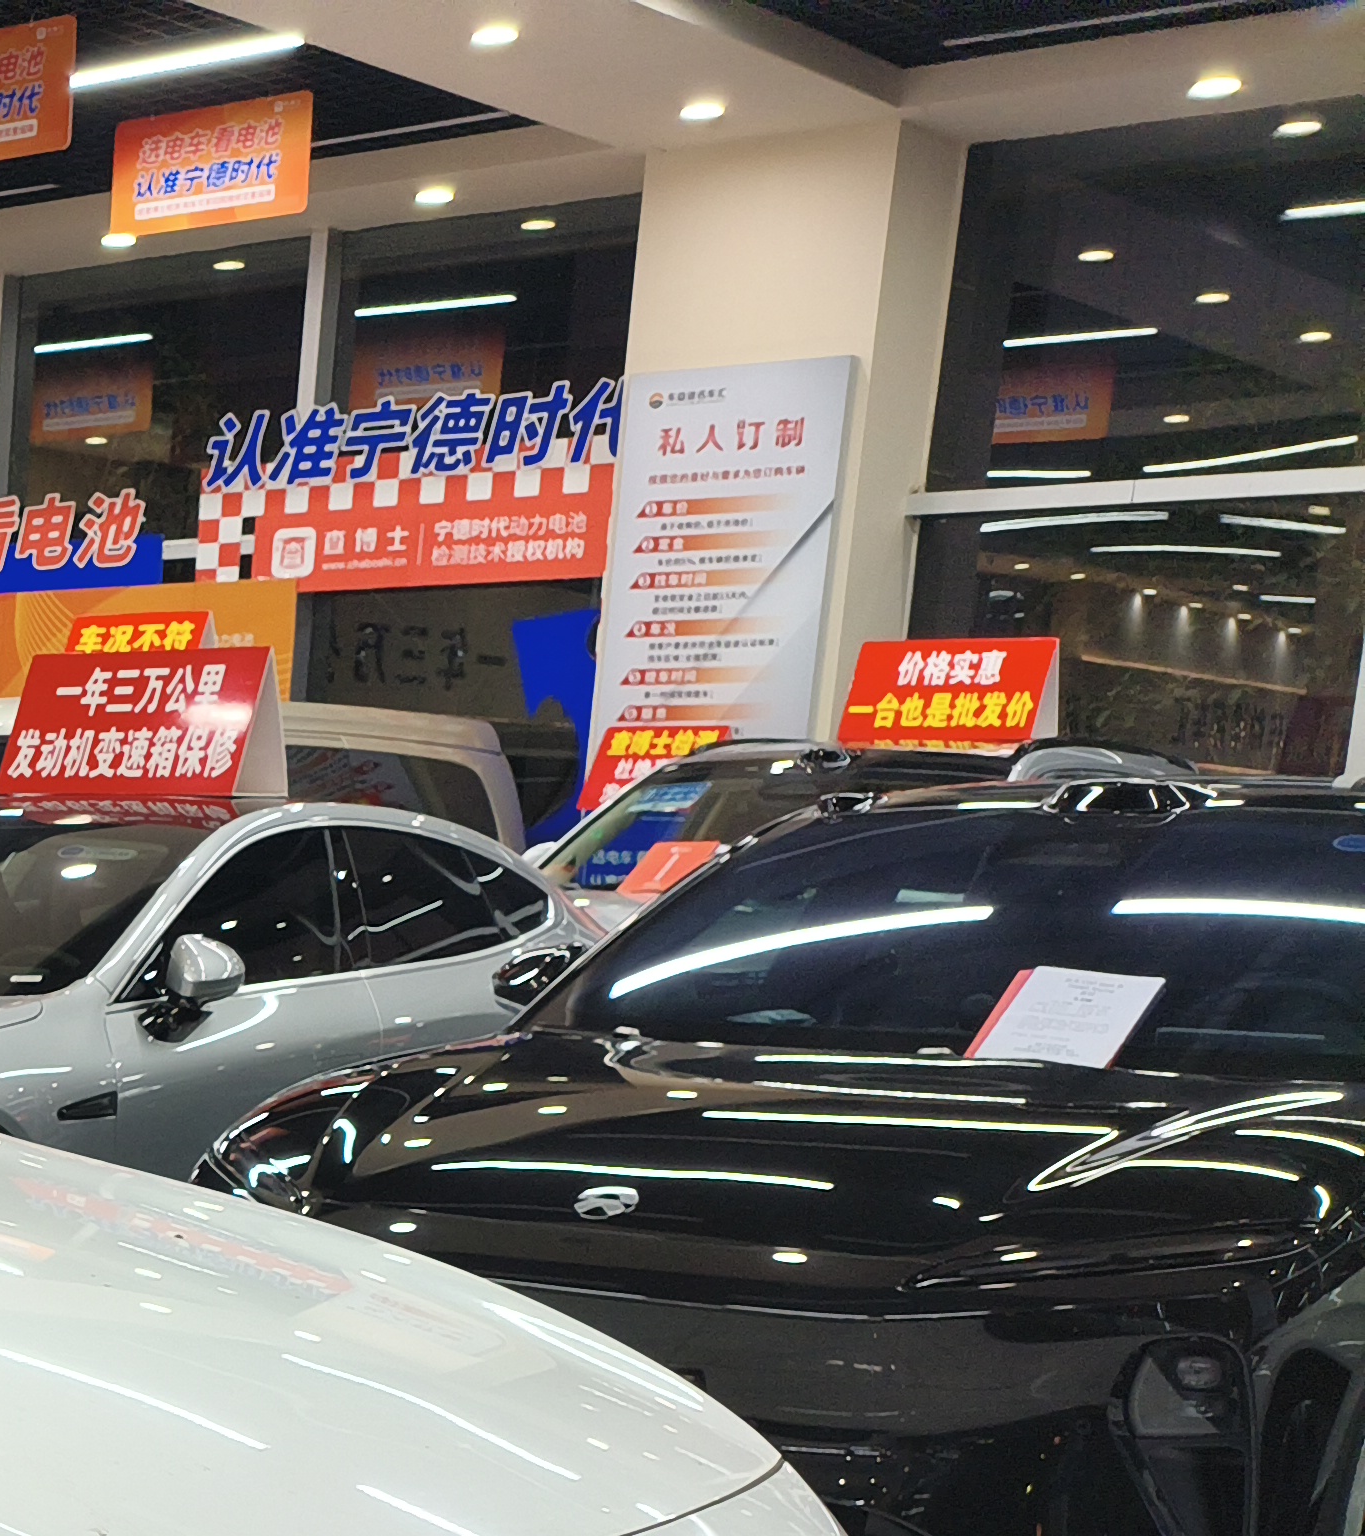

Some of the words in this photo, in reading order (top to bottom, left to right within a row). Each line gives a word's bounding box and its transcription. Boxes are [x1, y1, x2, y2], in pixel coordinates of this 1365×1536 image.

[138, 118, 283, 168] 选电车看电池
[134, 153, 280, 199] 认准宁德时代
[203, 377, 626, 491] 认准宁德时代
[657, 417, 805, 456] 私人订制
[323, 525, 409, 556] 查博士
[434, 512, 587, 542] 宁德时代动力电池
[431, 538, 585, 567] 检测技术授权机构
[75, 620, 195, 654] 车况不符
[897, 649, 1007, 687] 价格实惠
[56, 663, 227, 717] 一年三万公里
[848, 691, 1034, 729] 一台也是批发价
[7, 726, 238, 779] 发动机变速箱保修
